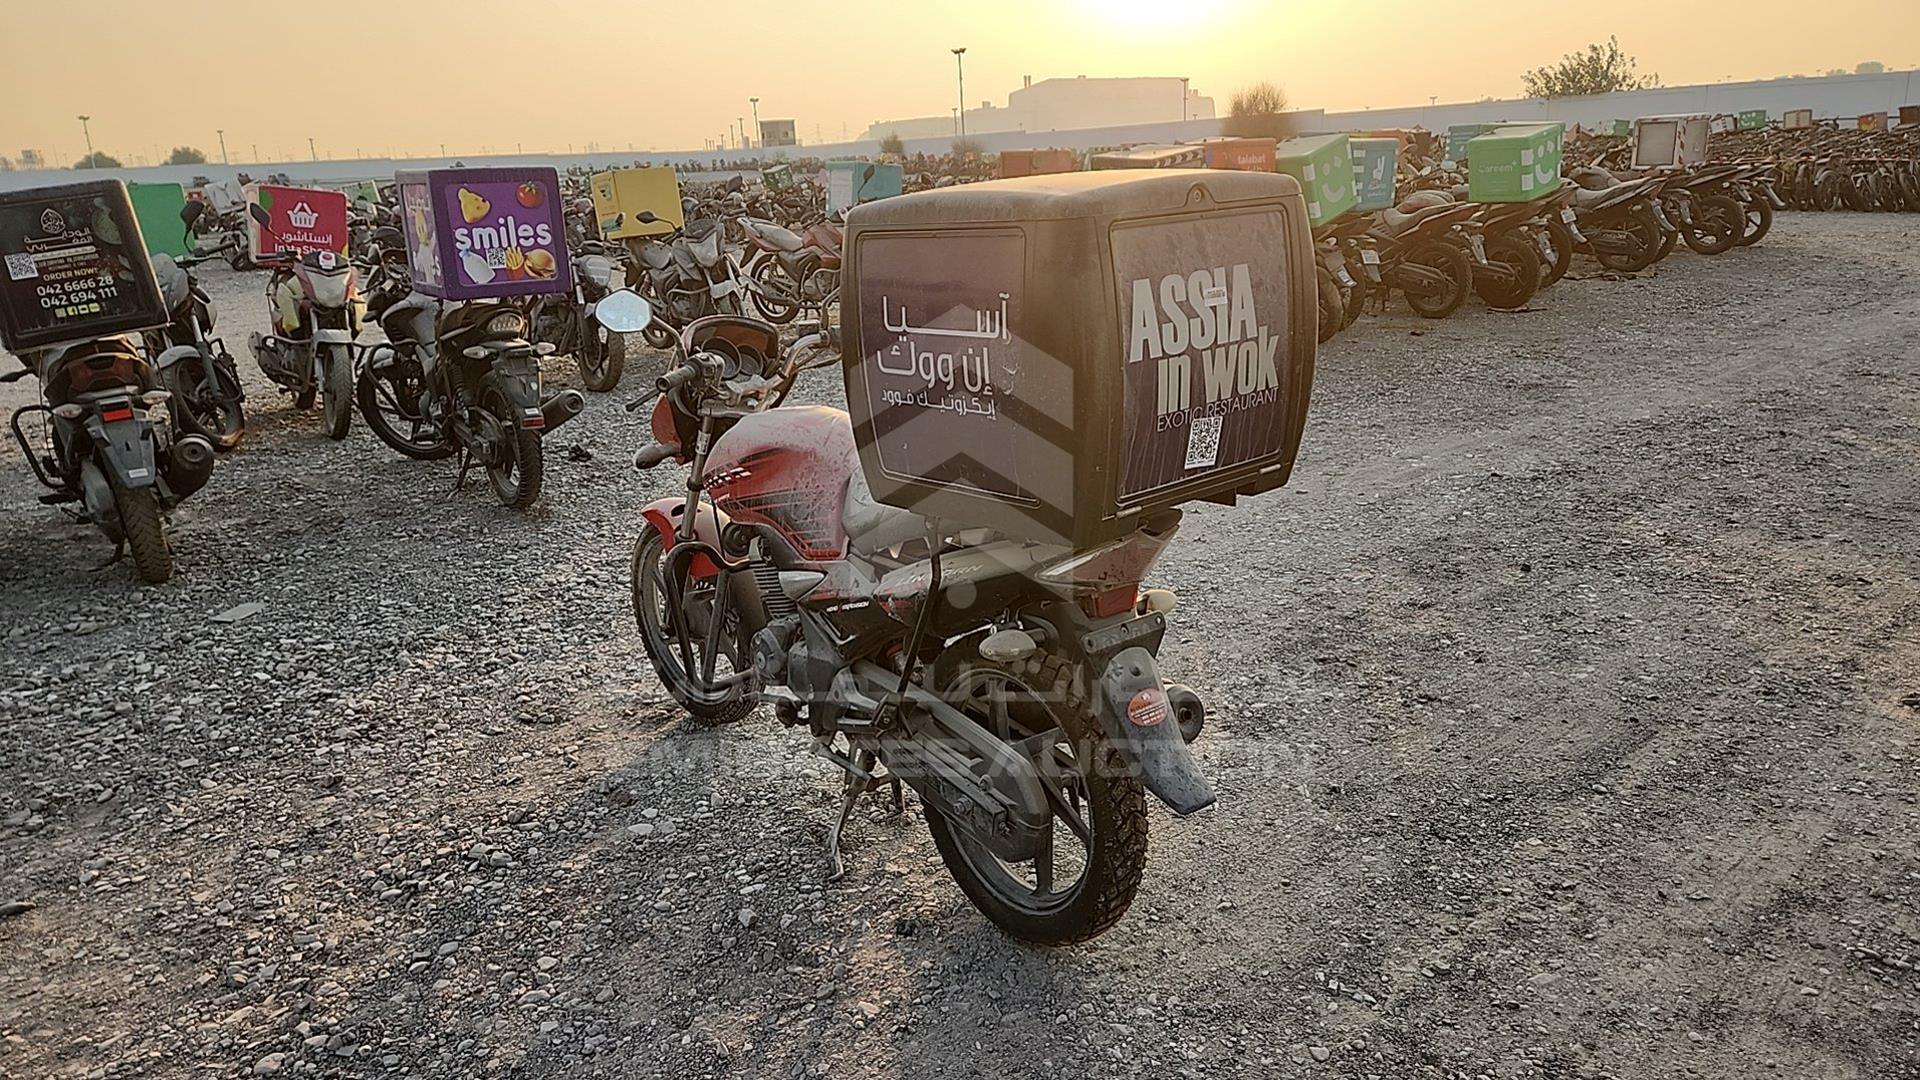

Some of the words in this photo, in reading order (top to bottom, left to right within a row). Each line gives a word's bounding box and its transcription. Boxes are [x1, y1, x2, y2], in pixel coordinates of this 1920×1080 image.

[454, 215, 552, 250] smiles
[37, 283, 63, 297] 042
[64, 278, 96, 292] 6666
[99, 275, 114, 288] 28
[40, 295, 69, 309] 042
[70, 291, 97, 305] 694
[98, 287, 118, 298] 111
[43, 270, 73, 282] ORDER
[881, 292, 1011, 343] آسيا
[1129, 263, 1258, 364] ASSIA
[876, 341, 955, 392] ووك
[962, 346, 994, 396] إن
[1156, 405, 1204, 433] EXOTIC
[1205, 386, 1280, 418] RESTAURANT
